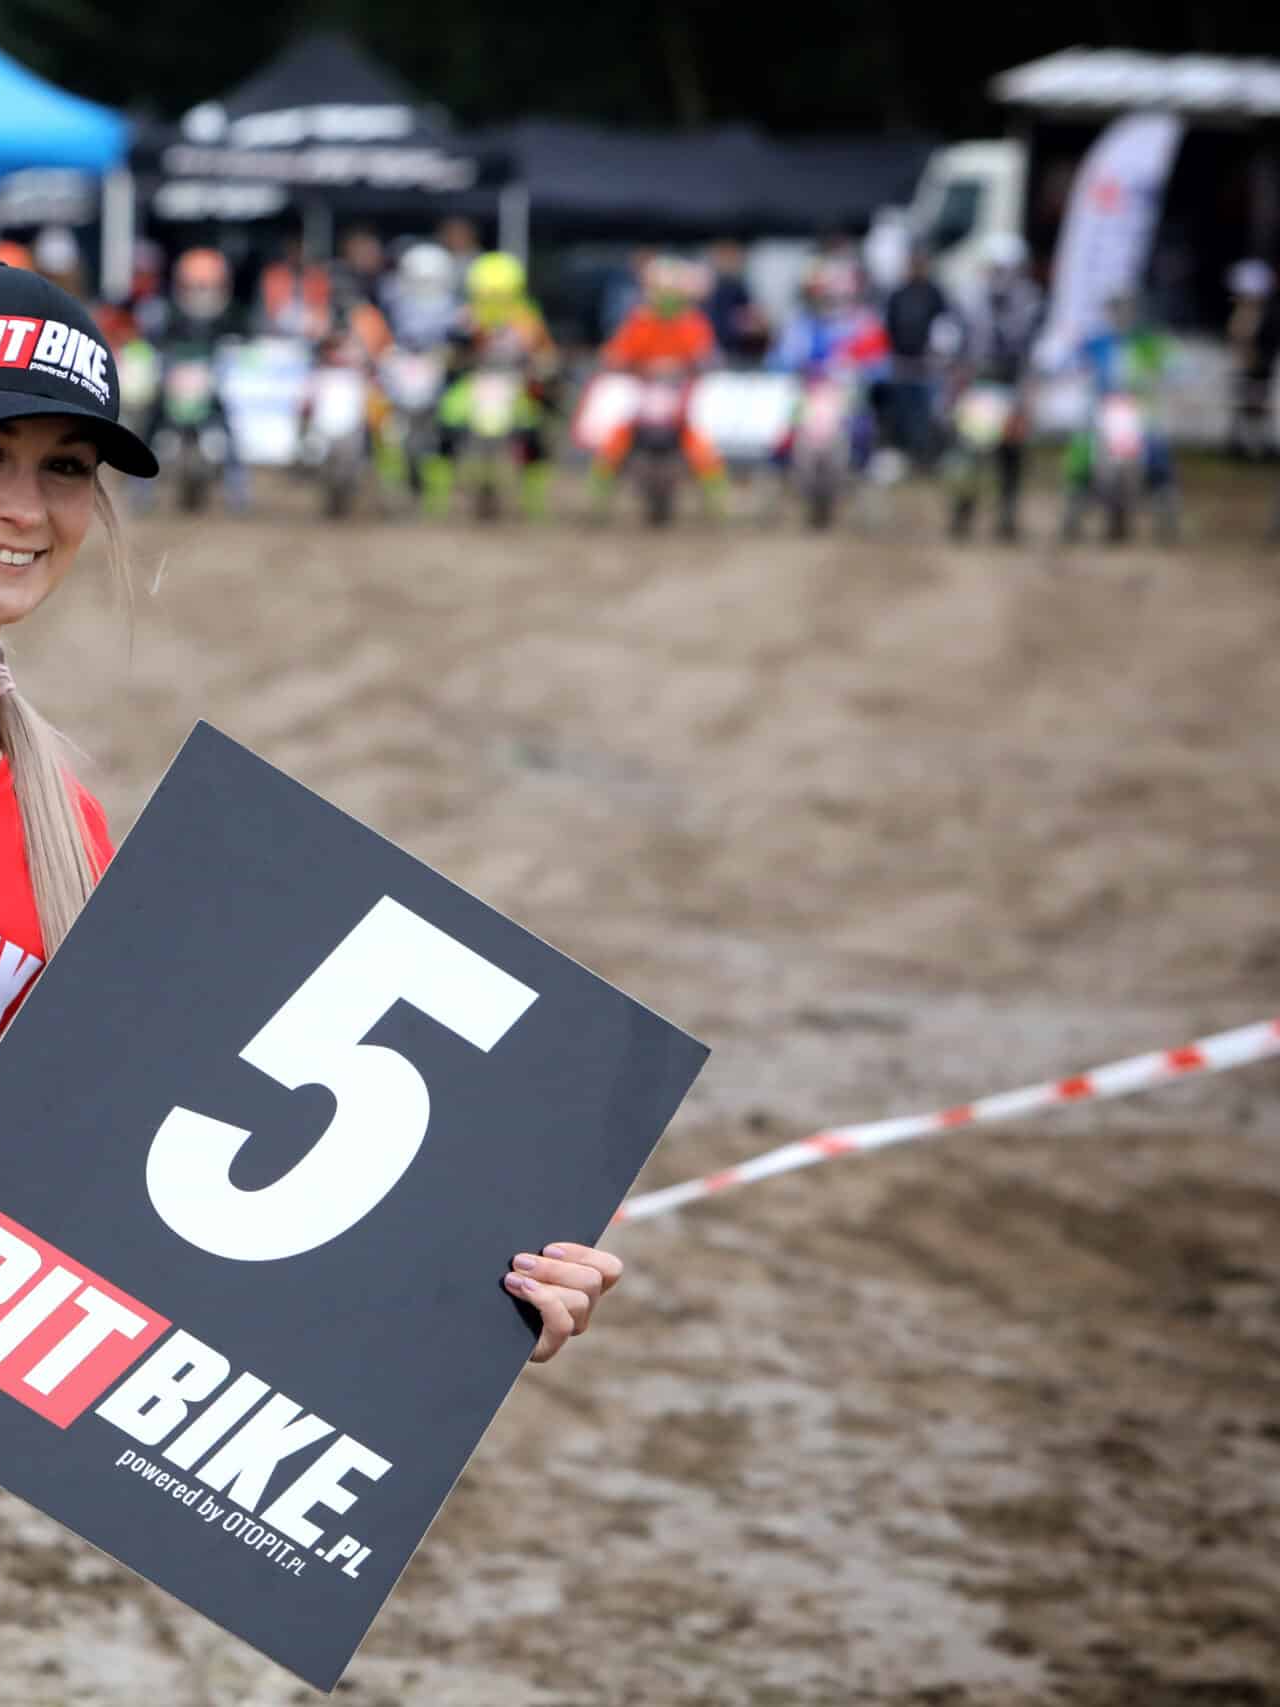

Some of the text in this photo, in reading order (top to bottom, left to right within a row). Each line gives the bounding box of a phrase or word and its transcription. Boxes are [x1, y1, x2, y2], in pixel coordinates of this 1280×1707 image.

[146, 894, 540, 1262] 5
[114, 1449, 308, 1577] powered by OTOPIT.PL
